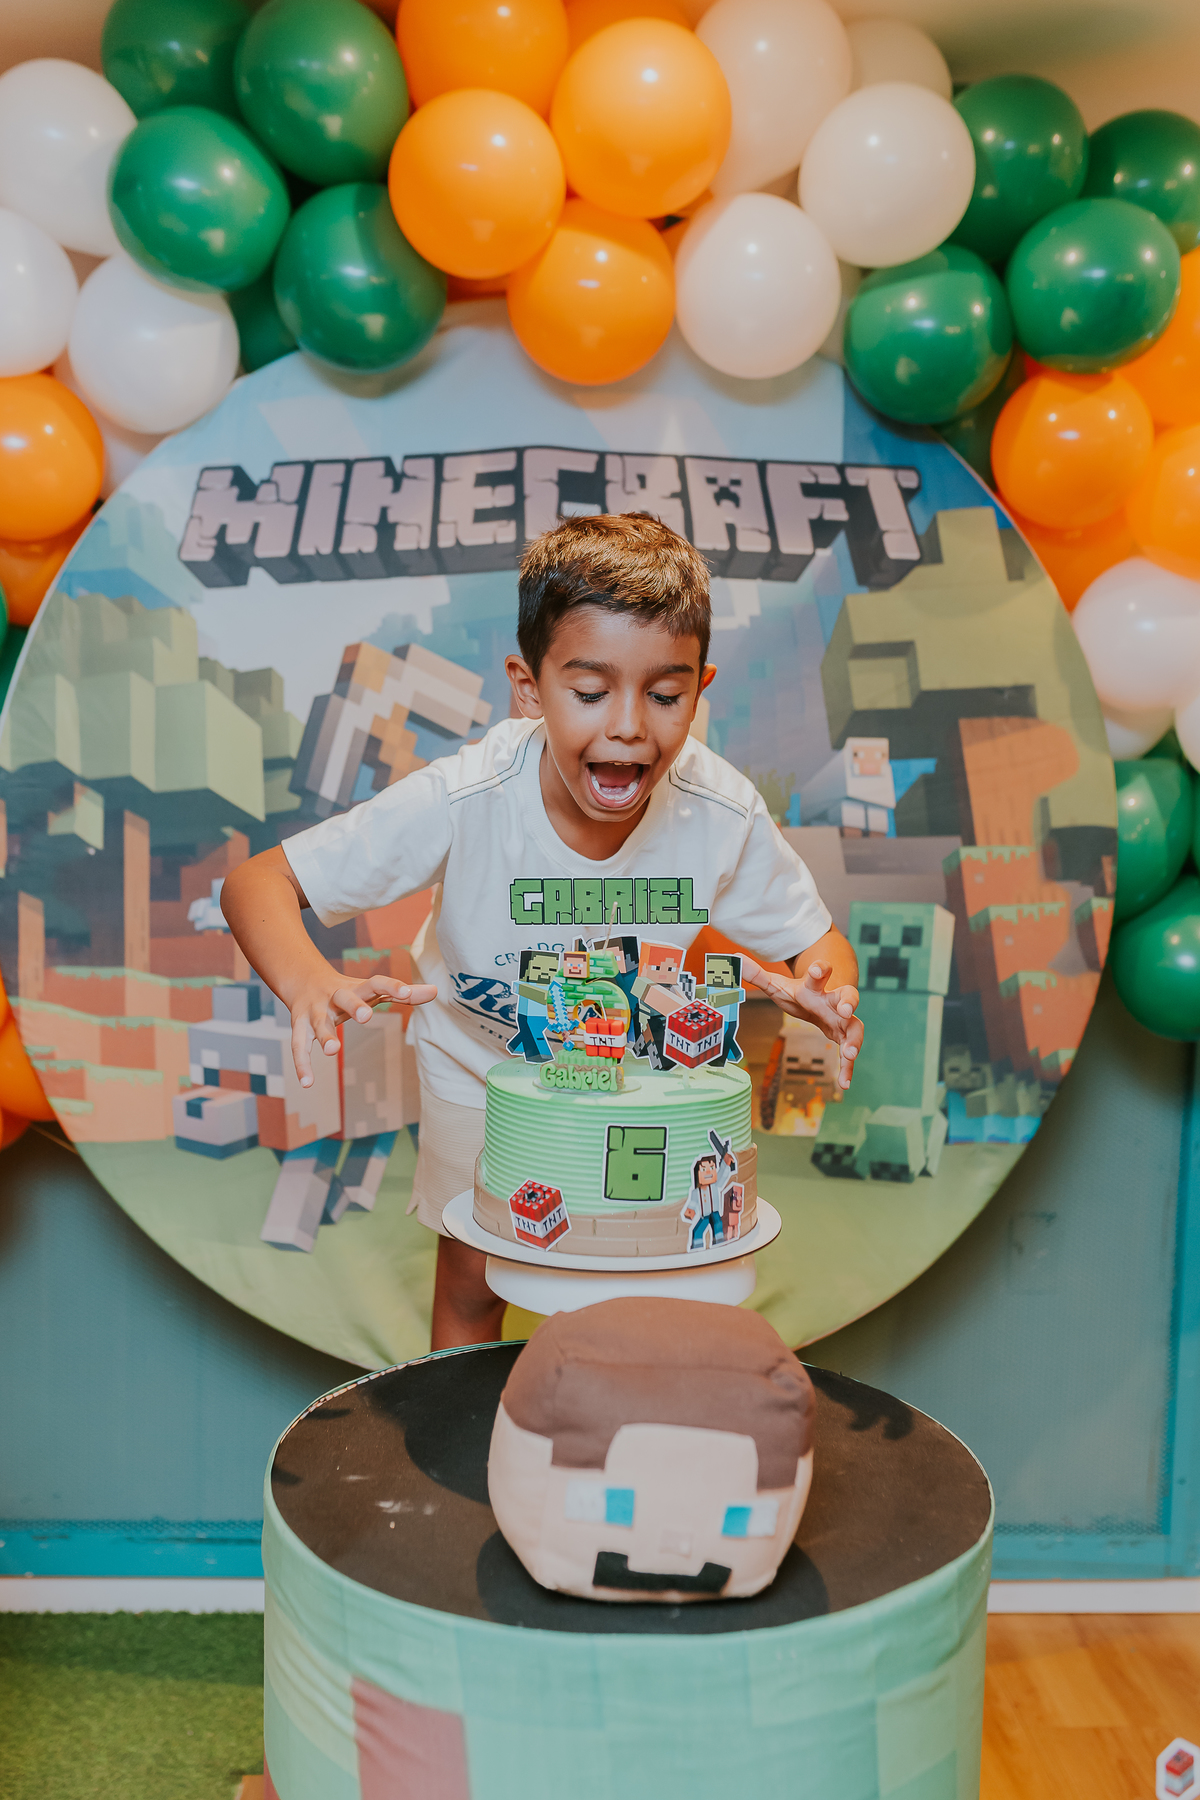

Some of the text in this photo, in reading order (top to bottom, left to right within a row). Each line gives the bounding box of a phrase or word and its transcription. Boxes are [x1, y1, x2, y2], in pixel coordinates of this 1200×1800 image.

[178, 446, 922, 588] MINECRAFT
[510, 877, 710, 925] GABRIEL
[589, 1036, 616, 1047] TNT
[670, 1032, 720, 1053] TNT TNT
[540, 1063, 619, 1092] Gabriel
[604, 1125, 667, 1202] 6
[515, 1207, 562, 1234] TNT TNT
